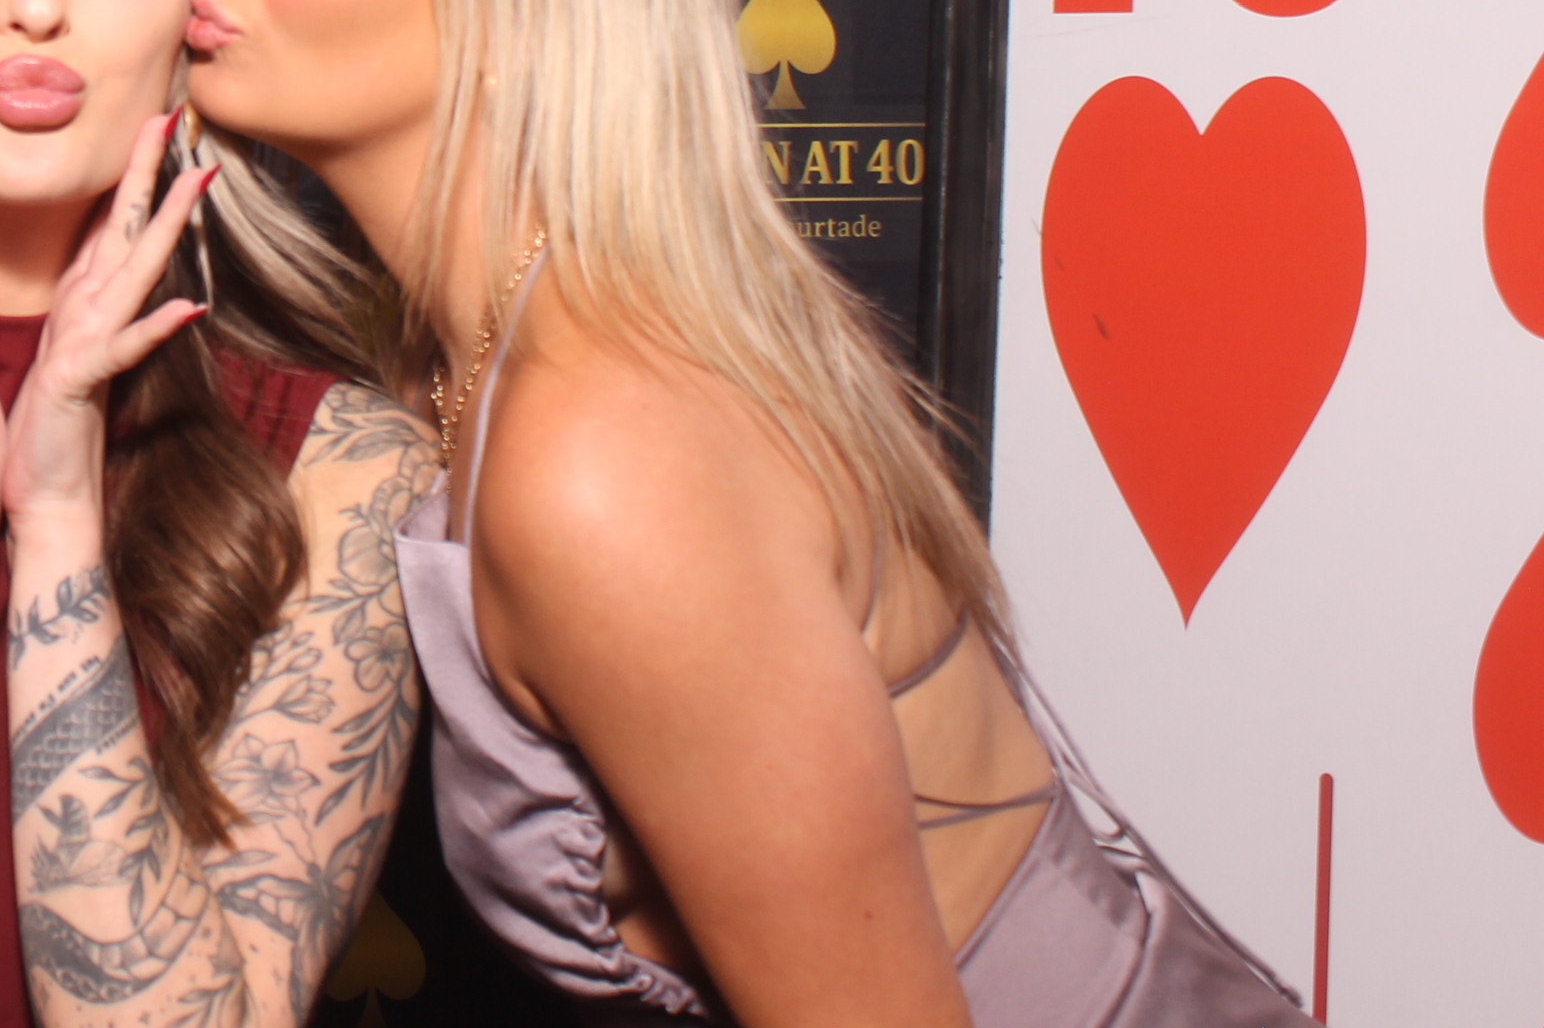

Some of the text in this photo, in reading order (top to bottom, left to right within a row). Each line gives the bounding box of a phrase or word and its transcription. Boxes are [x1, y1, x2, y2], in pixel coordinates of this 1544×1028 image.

[761, 139, 926, 186] N AT 40
[797, 214, 882, 238] urtade
